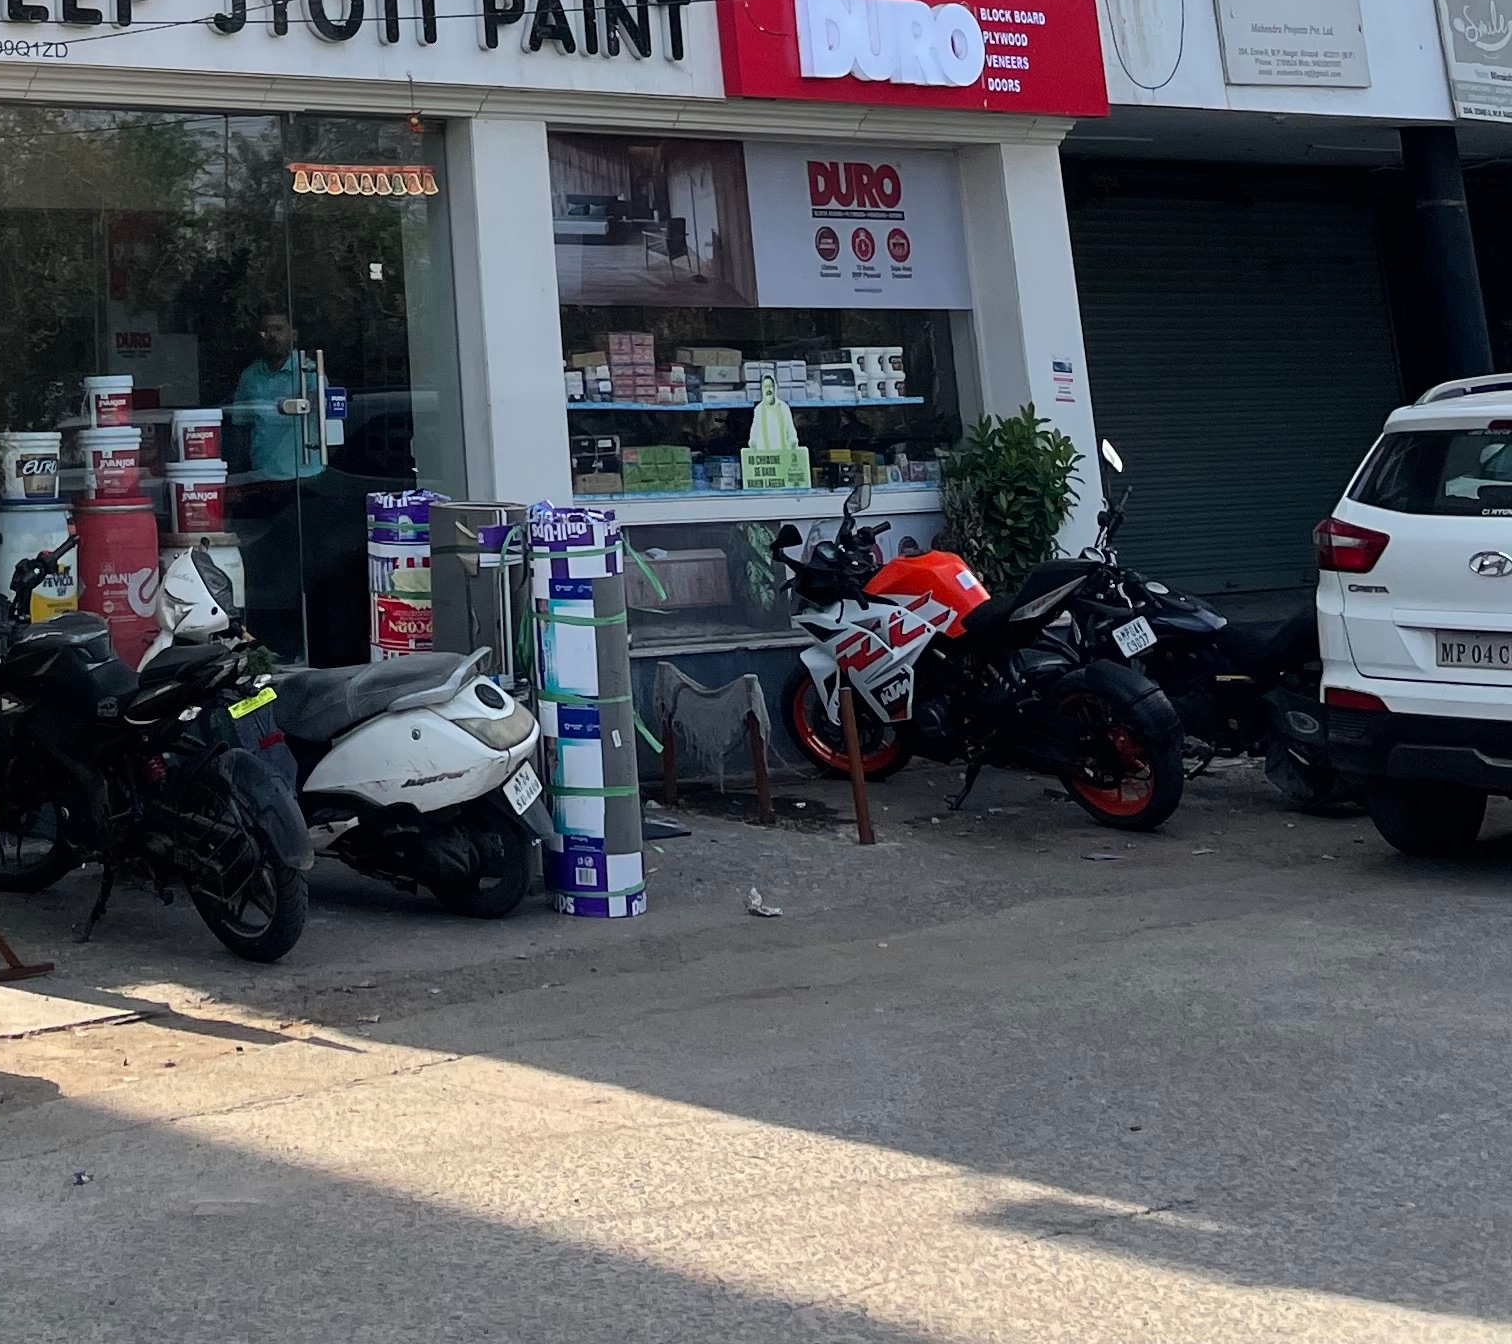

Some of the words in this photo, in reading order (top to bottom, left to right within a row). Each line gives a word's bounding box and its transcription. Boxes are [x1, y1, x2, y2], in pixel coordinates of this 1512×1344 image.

[980, 7, 1012, 23] BLOCK
[1013, 10, 1046, 26] BOARD
[982, 30, 1028, 47] PLYWOOD
[986, 54, 1030, 70] VENEERS
[988, 77, 1021, 93] DOORS
[806, 160, 902, 209] DURO
[1441, 642, 1467, 663] MP
[1471, 643, 1494, 664] 04
[880, 678, 909, 706] KTM
